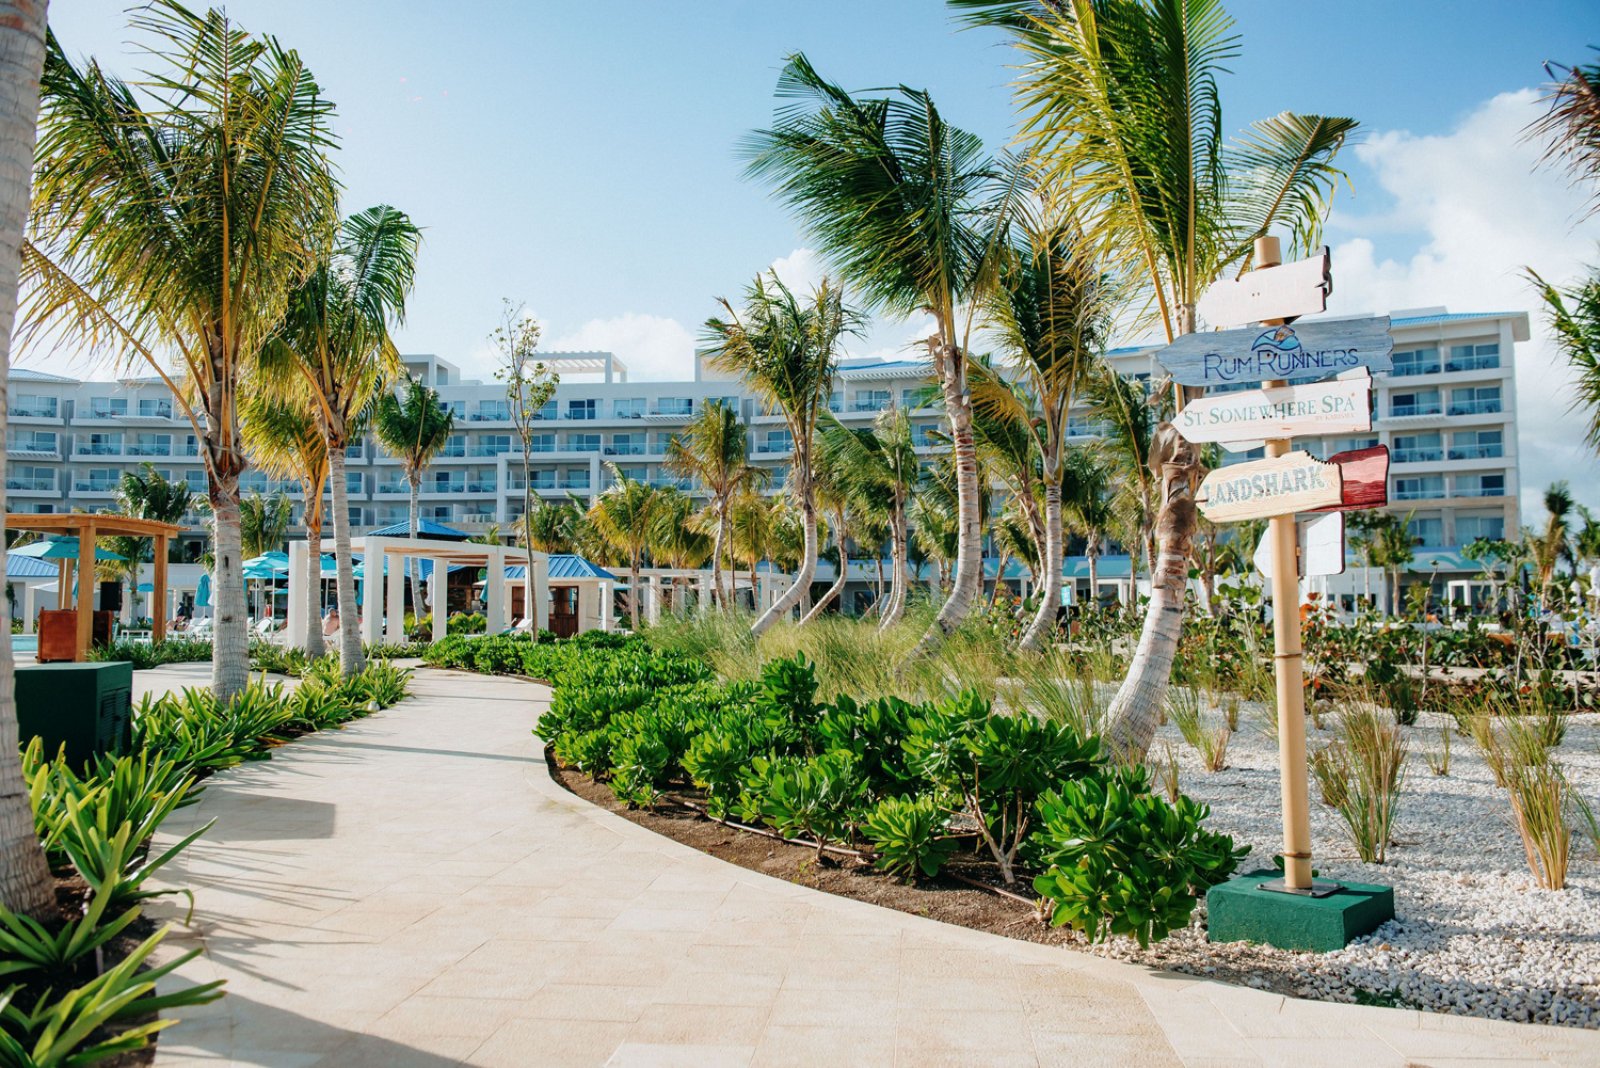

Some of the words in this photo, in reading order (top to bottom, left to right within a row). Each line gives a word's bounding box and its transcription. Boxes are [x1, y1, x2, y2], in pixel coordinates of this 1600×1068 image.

[1257, 348, 1359, 376] RUNNERS
[1209, 400, 1316, 425] SOMEWHERE
[1322, 395, 1355, 413] SPA
[1203, 465, 1325, 508] LANDSHARK
